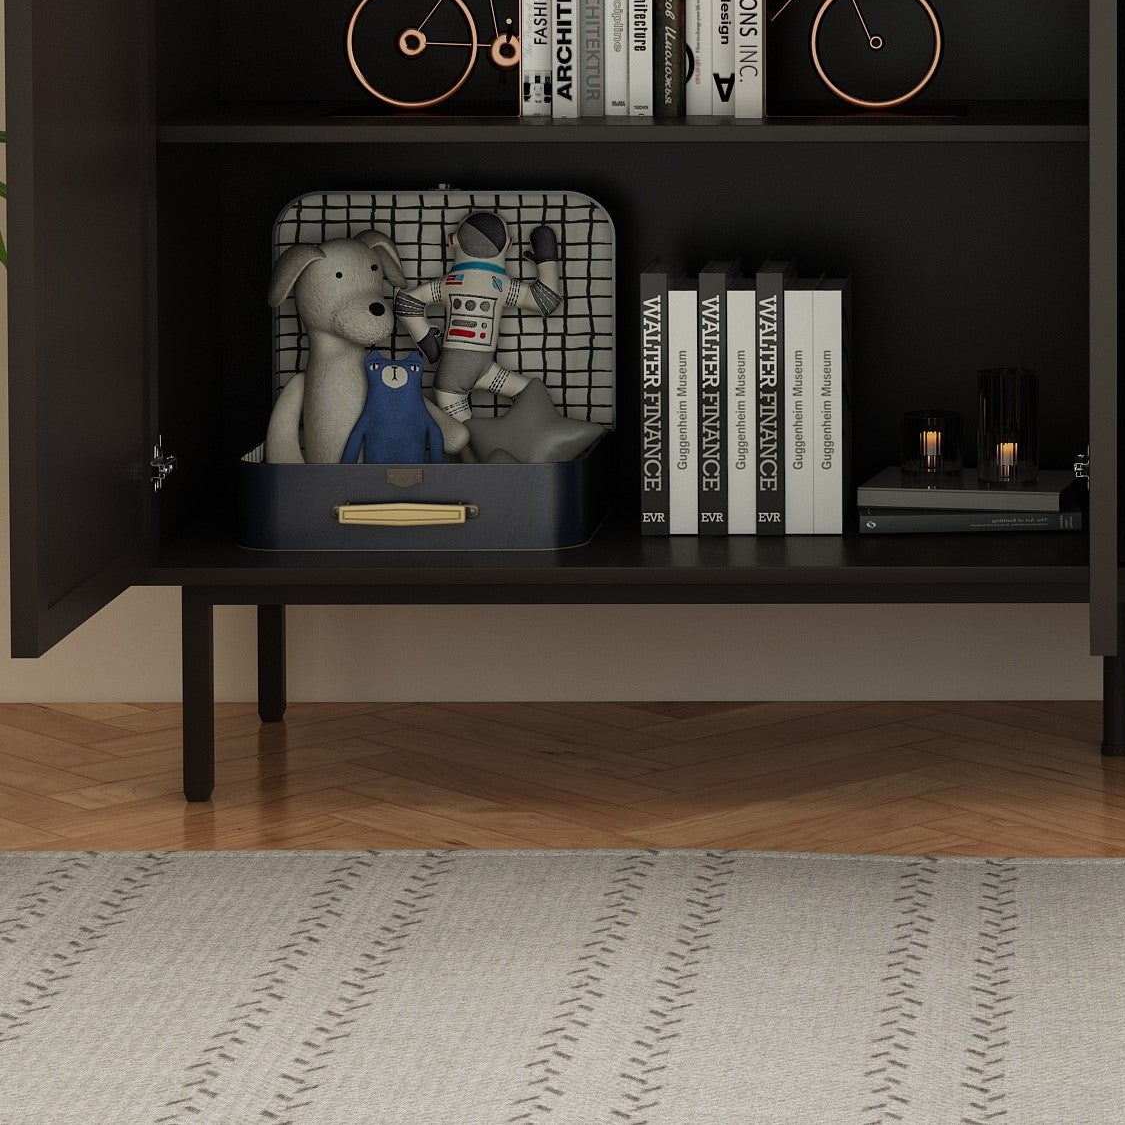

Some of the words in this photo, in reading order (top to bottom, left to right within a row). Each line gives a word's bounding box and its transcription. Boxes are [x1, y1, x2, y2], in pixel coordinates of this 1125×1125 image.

[739, 45, 758, 83] INC.
[643, 294, 662, 389] WALTER
[676, 349, 687, 397] Museum
[701, 294, 720, 389] WALTER
[736, 349, 746, 397] Museum
[758, 294, 777, 389] WALTER
[792, 349, 802, 397] Museum
[821, 349, 832, 397] Museum
[644, 391, 662, 492] FINANCE
[676, 400, 690, 470] Guggenheim
[702, 391, 720, 492] FINANCE
[736, 400, 749, 470] Guggenheim
[759, 391, 778, 492] FINANCE
[792, 400, 806, 470] Guggenheim
[821, 400, 834, 470] Guggenheim
[642, 512, 665, 523] EVR
[701, 512, 724, 523] EVR
[758, 512, 781, 523] EVR
